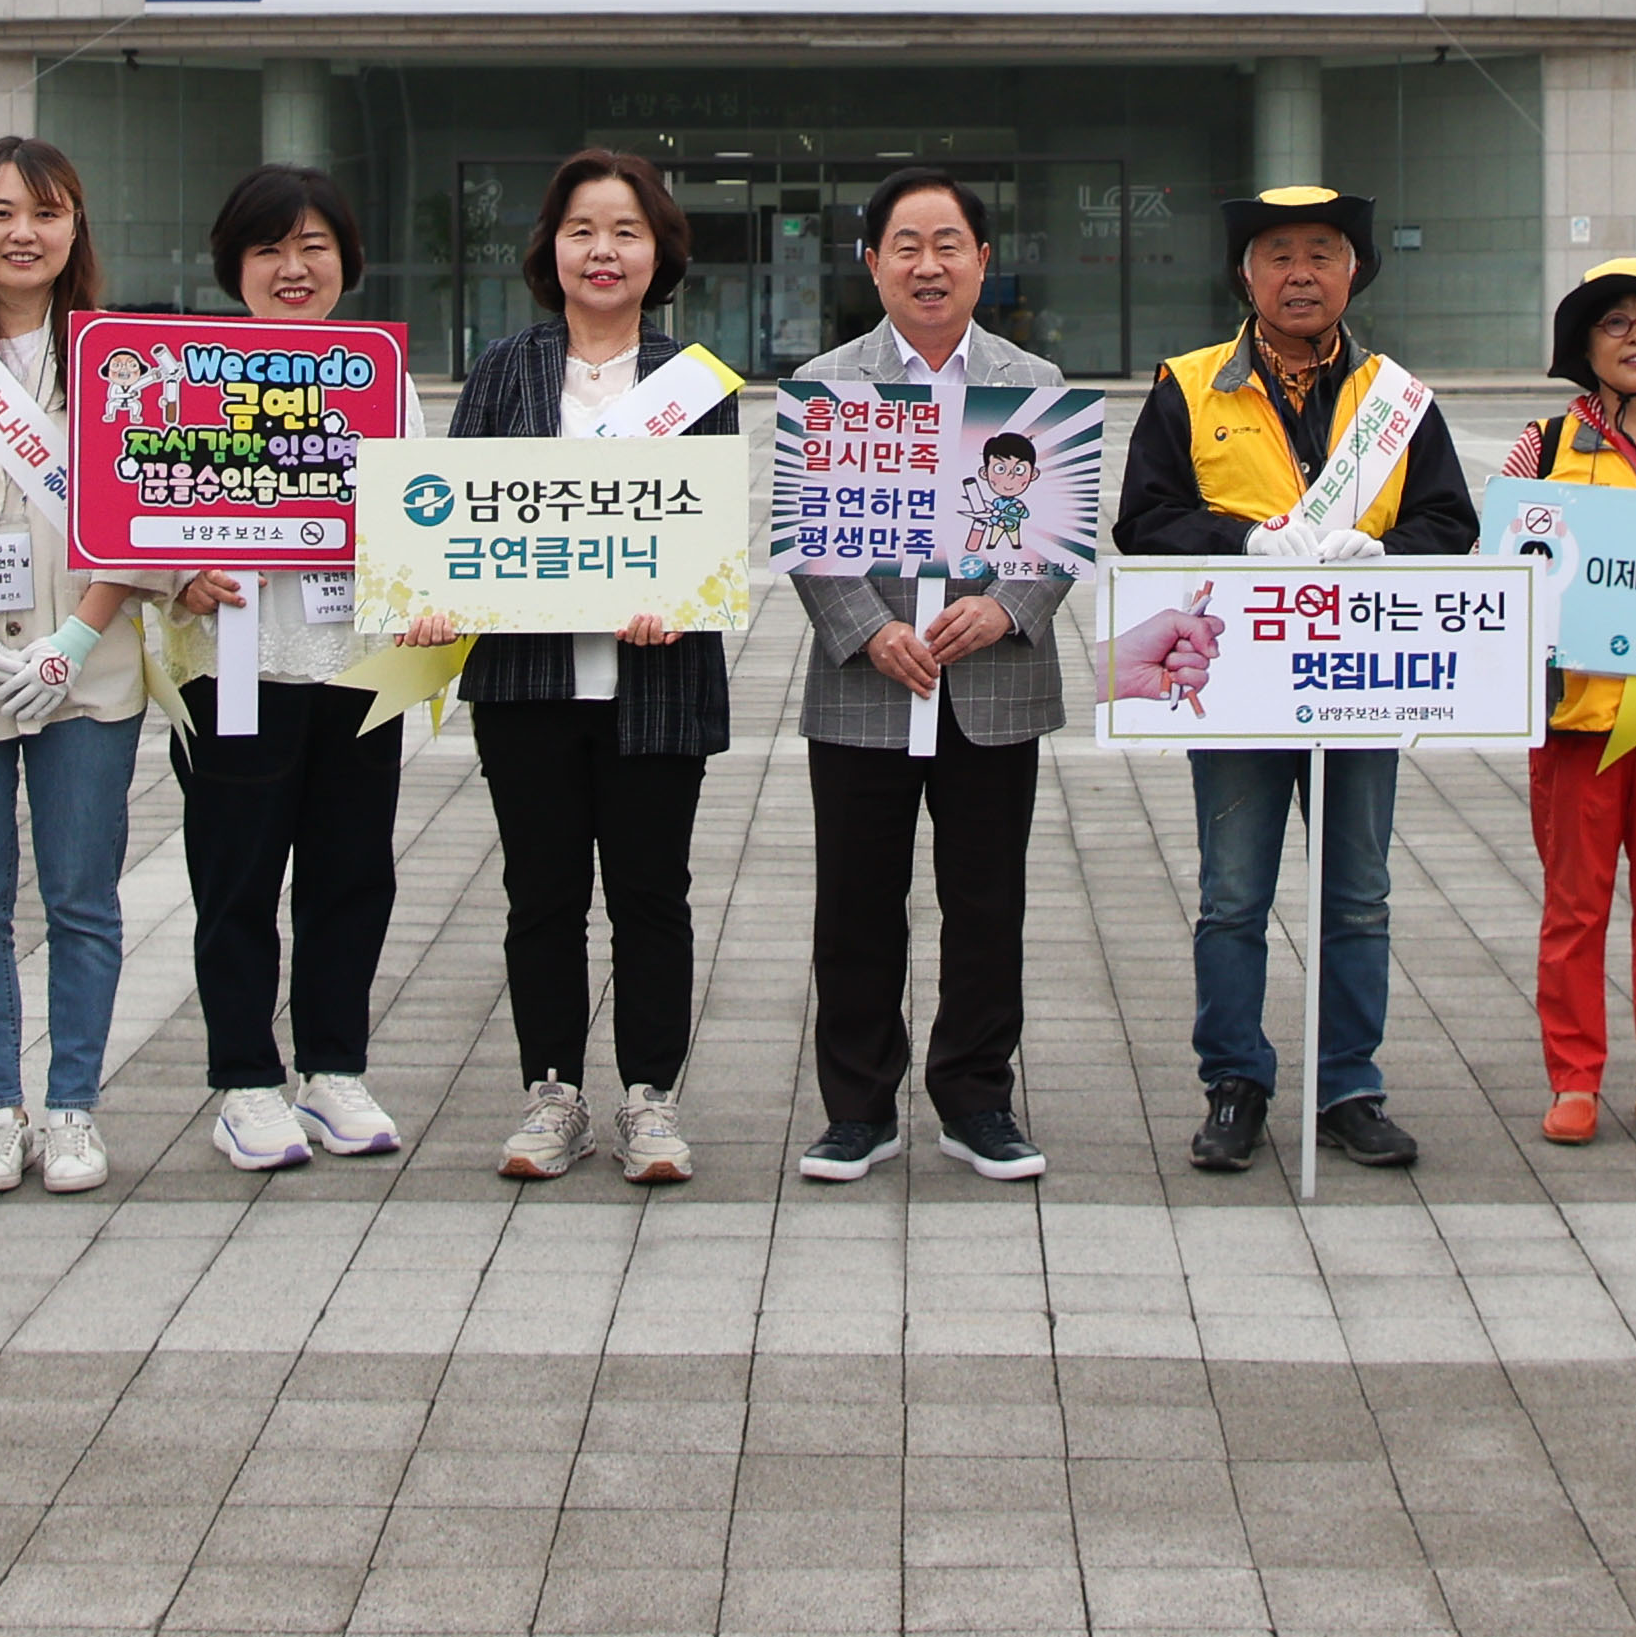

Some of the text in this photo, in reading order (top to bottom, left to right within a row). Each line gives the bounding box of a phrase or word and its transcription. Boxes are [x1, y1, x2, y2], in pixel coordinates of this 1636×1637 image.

[223, 383, 321, 431] 금연!
[802, 397, 942, 435] 흡연하면
[1377, 409, 1412, 456] 없는
[801, 439, 941, 474] 일시만족
[465, 478, 704, 524] 남양주보건소
[797, 485, 936, 520] 금연하면
[181, 524, 285, 541] 남양주보건소
[796, 525, 936, 563] 평생만족
[443, 534, 659, 580] 금연클리닉
[987, 560, 1082, 576] 남양주보건소
[1435, 591, 1506, 632] 당신
[1292, 651, 1458, 691] 멋집니다!
[1318, 706, 1455, 721] 남양주보건소 금연클리닉
